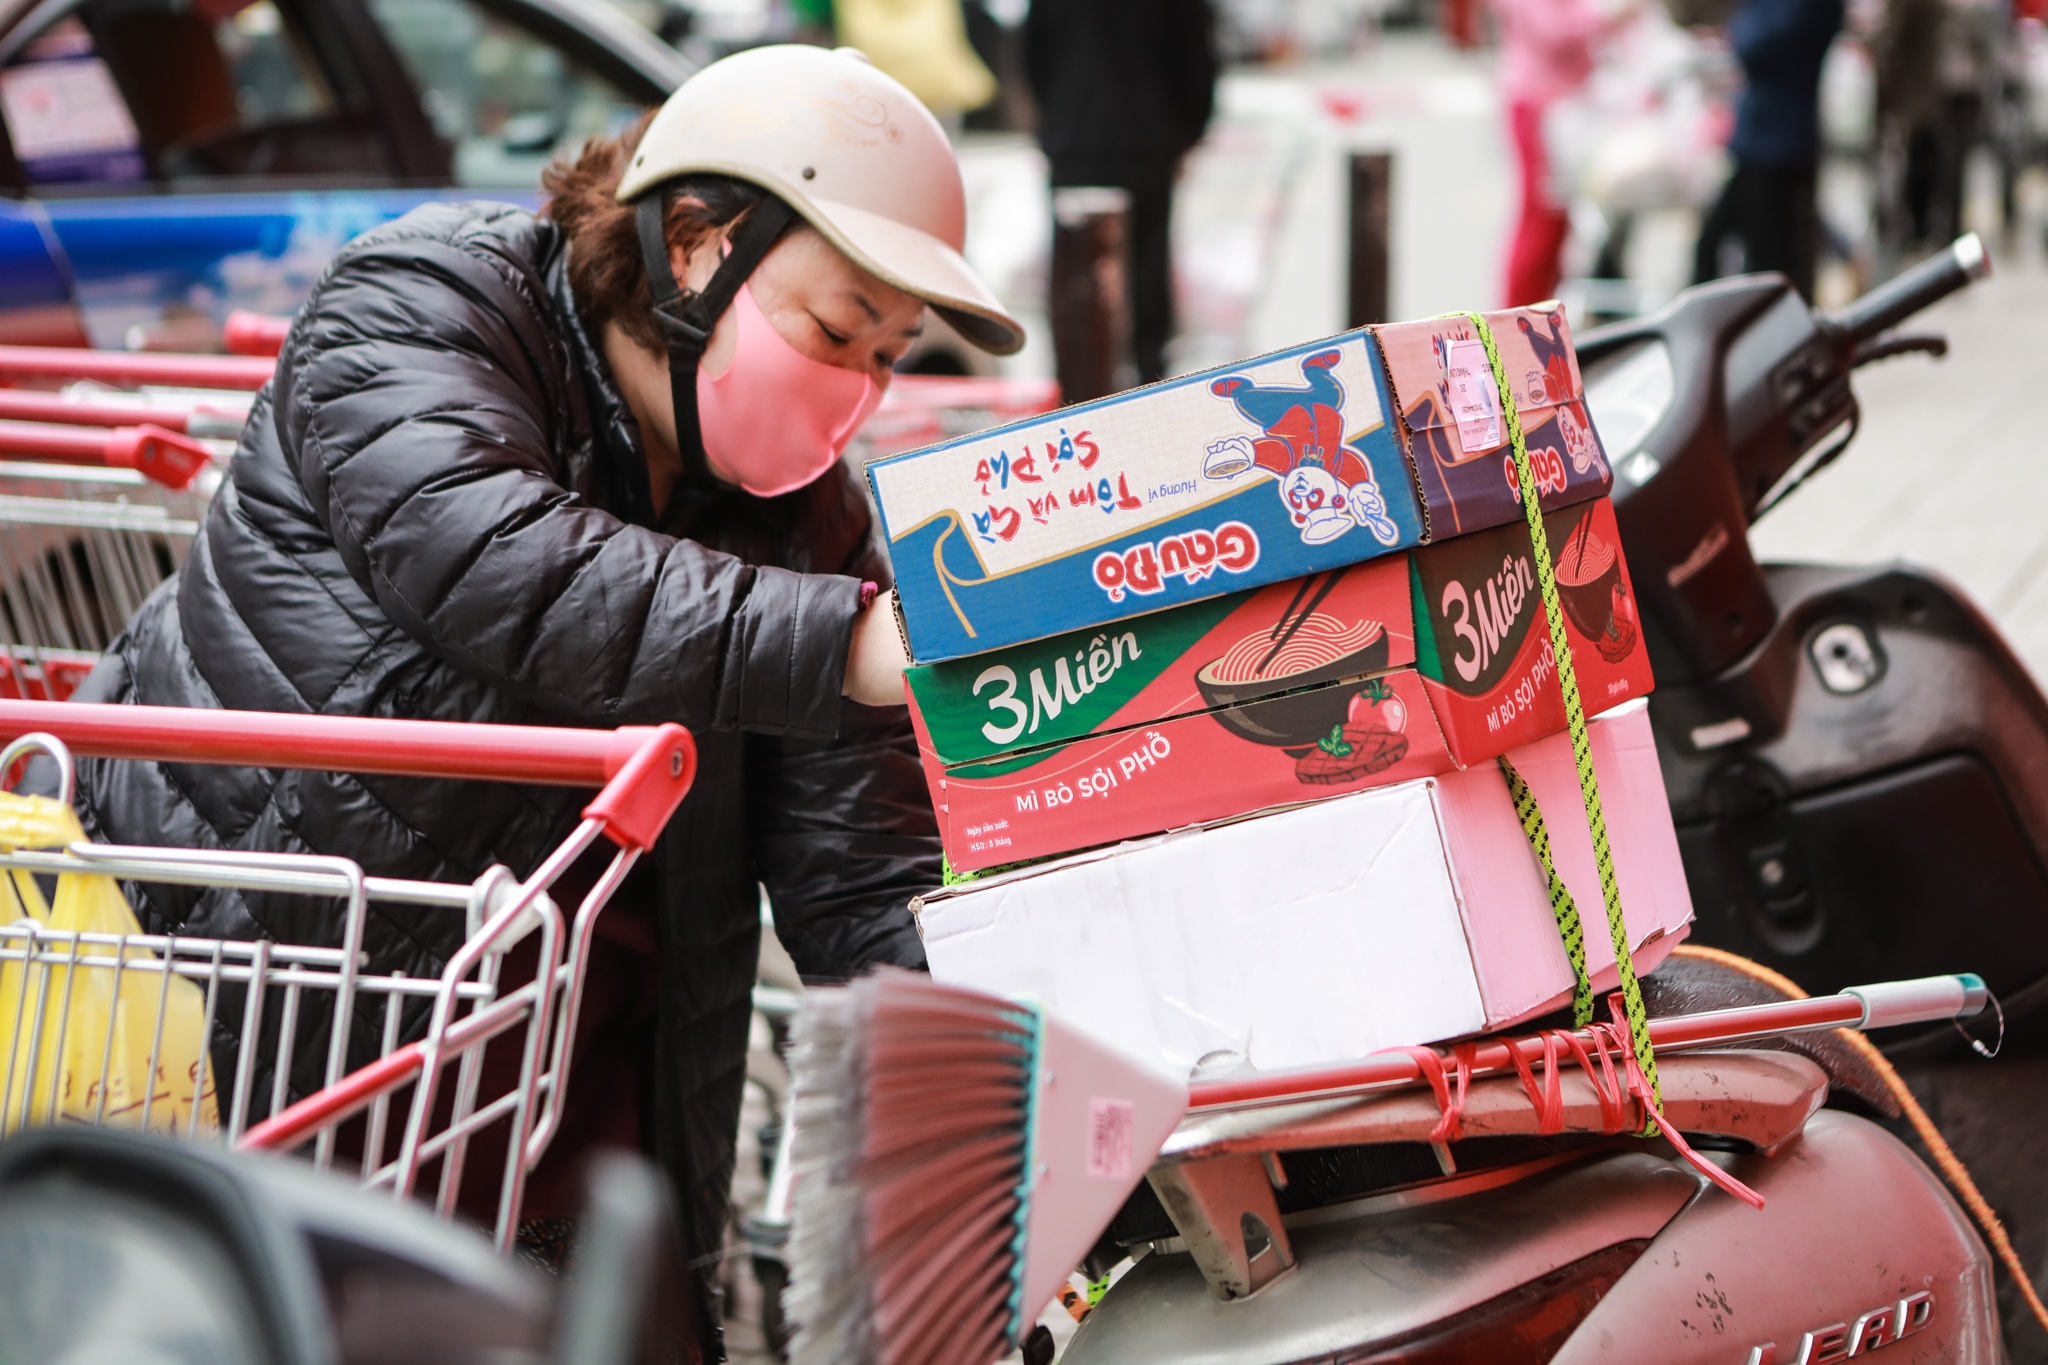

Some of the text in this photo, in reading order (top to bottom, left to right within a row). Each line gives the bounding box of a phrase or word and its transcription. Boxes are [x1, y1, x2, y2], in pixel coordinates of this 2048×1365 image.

[973, 428, 1100, 496] Sợi Phở
[1148, 479, 1197, 502] Hương vị
[971, 471, 1142, 545] Tôm và Gà
[1094, 523, 1258, 601] Gấu Đỏ
[1486, 637, 1555, 732] MÌ BÒ SỢI PHỞ
[1016, 731, 1172, 812] MÌ BÒ SỢI PHỞ
[966, 826, 982, 837] Ngày
[970, 842, 988, 852] HSD:
[1746, 1289, 1937, 1365] LEAD
